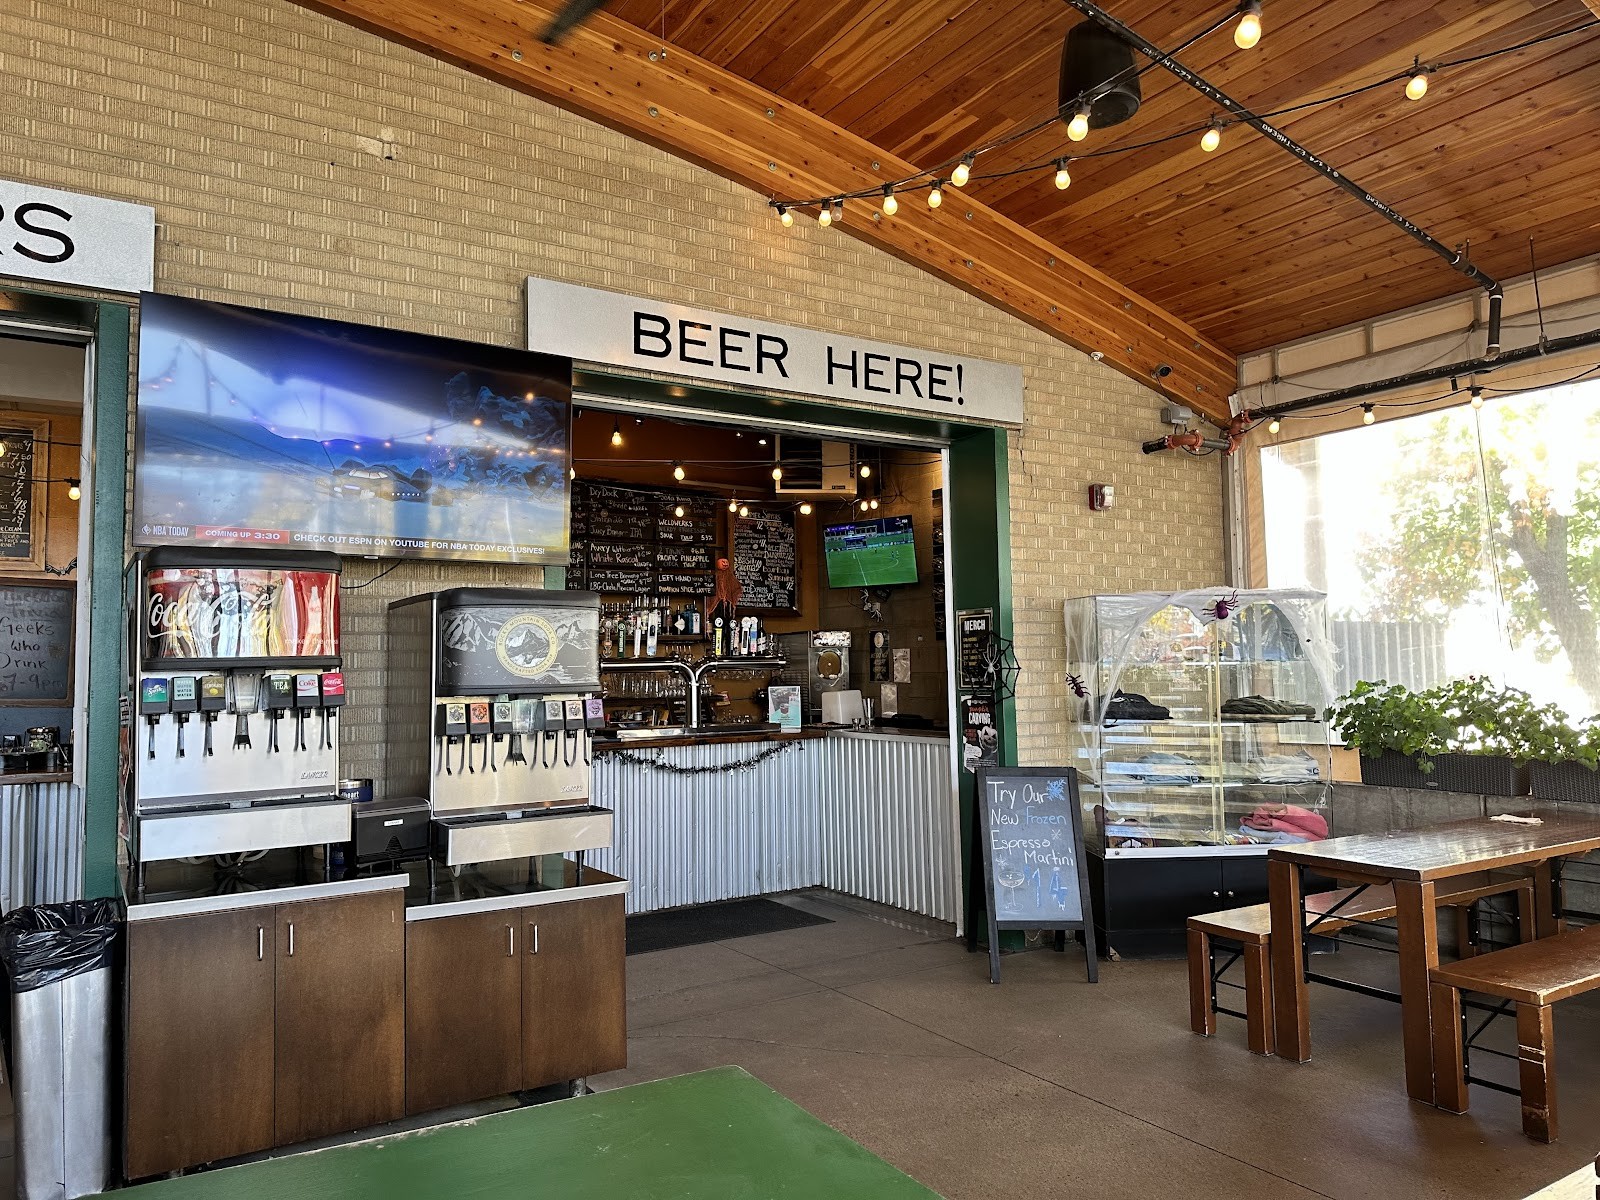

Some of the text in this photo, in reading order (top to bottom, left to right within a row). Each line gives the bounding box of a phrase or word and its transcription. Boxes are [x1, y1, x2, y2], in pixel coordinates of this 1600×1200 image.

[633, 311, 964, 406] BEER HERE!
[602, 487, 619, 498] Dock
[658, 519, 693, 527] WELDWERKS
[153, 525, 189, 536] NBA TODAY
[205, 529, 238, 538] COMING
[294, 533, 326, 543] CHECK
[328, 535, 346, 544] OUT
[349, 537, 372, 545] ESPN
[375, 538, 387, 546] ON
[389, 539, 429, 548] YOUTUBE
[450, 542, 468, 550] NBA
[468, 544, 496, 552] TODAY
[497, 545, 545, 555] EXCLUSIVES!
[616, 553, 638, 563] Rascal
[0, 616, 55, 635] Geeks
[510, 616, 540, 627] MOUNTAIN
[964, 620, 986, 630] MERCH
[274, 682, 289, 690] TEA
[987, 781, 1049, 809] Try Our
[991, 806, 1067, 826] New Frozen
[990, 830, 1051, 855] Espresso
[1024, 847, 1074, 866] Martini
